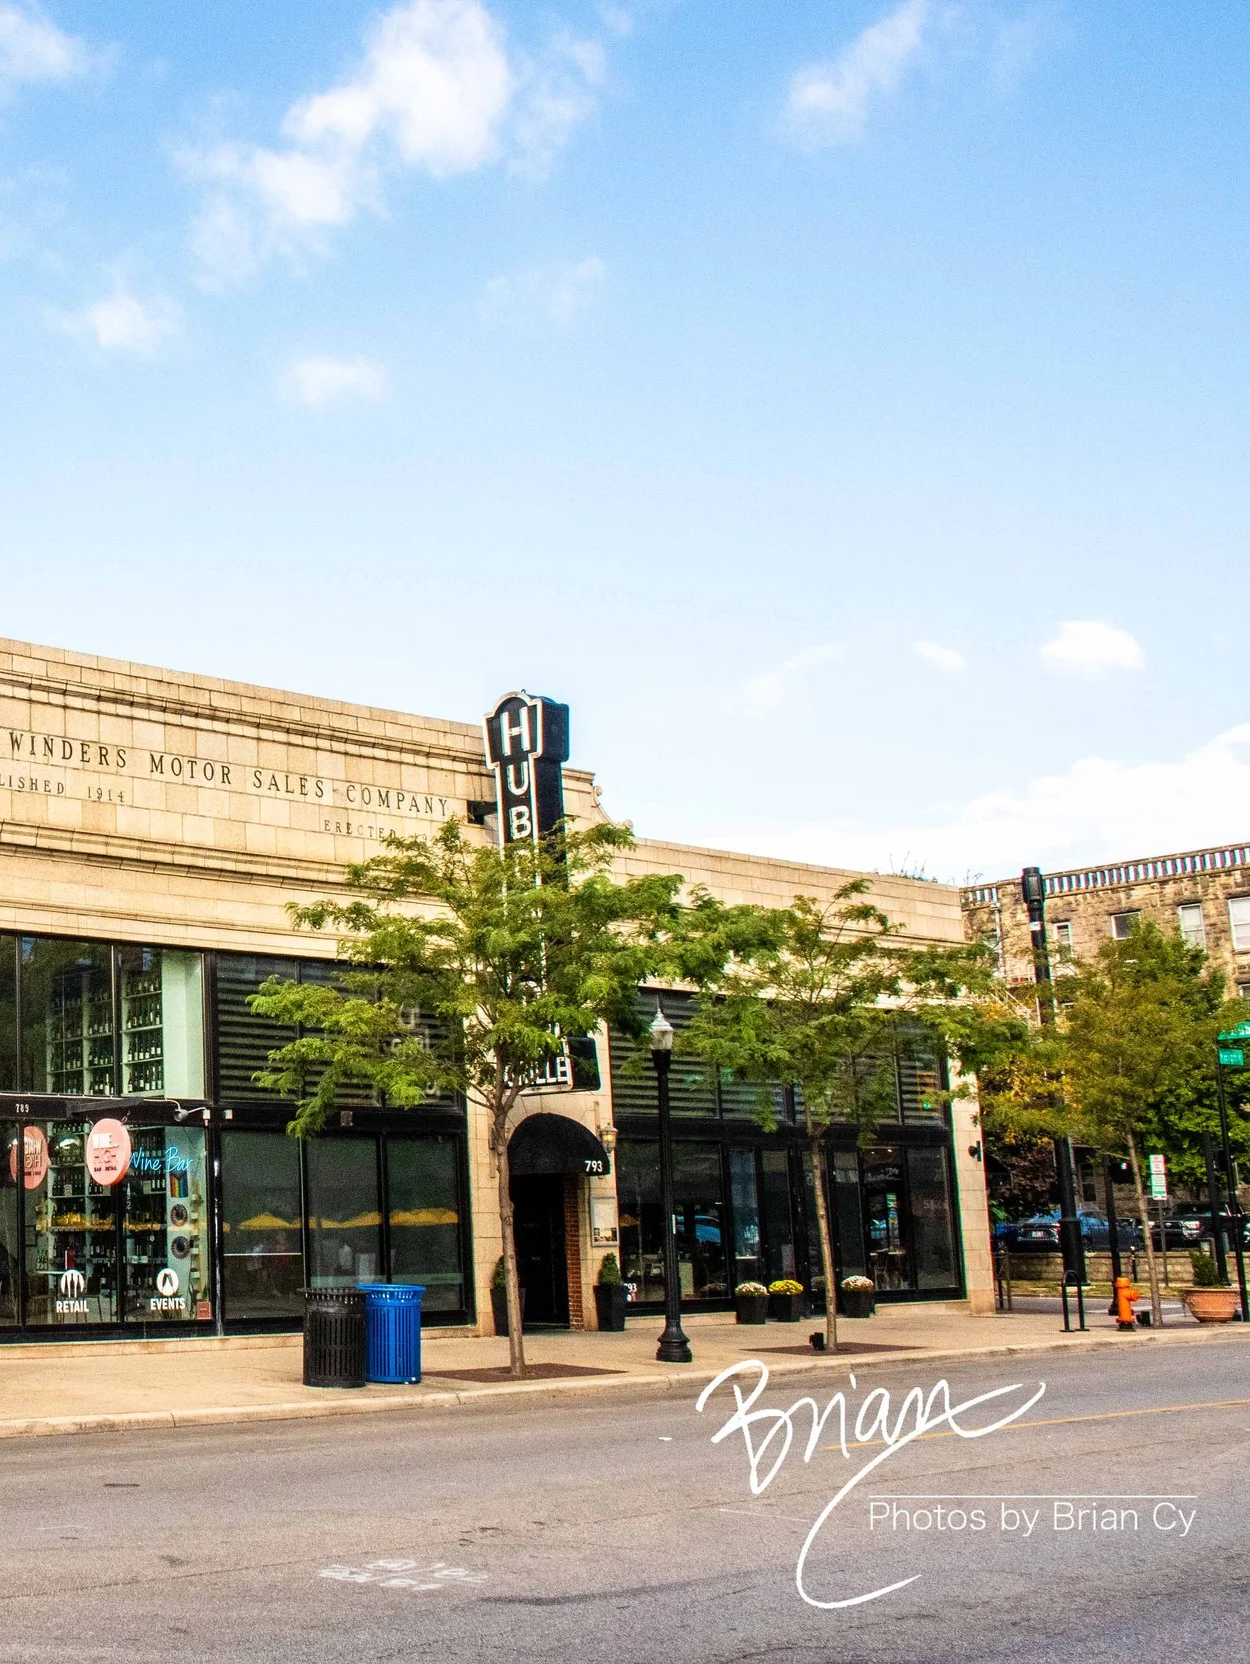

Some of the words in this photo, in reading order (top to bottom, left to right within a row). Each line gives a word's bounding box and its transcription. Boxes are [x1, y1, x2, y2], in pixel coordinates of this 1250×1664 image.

[8, 731, 127, 768] WINDERS
[150, 752, 232, 785] MOTOR
[253, 769, 325, 798] SALES
[346, 784, 449, 817] COMPANY
[87, 787, 125, 803] 1914
[324, 819, 397, 840] ERECTED
[15, 1103, 30, 1113] 789
[165, 1145, 194, 1172] Bar
[584, 1160, 603, 1172] 793
[56, 1300, 89, 1313] RETAIL
[150, 1297, 186, 1311] EVENTS
